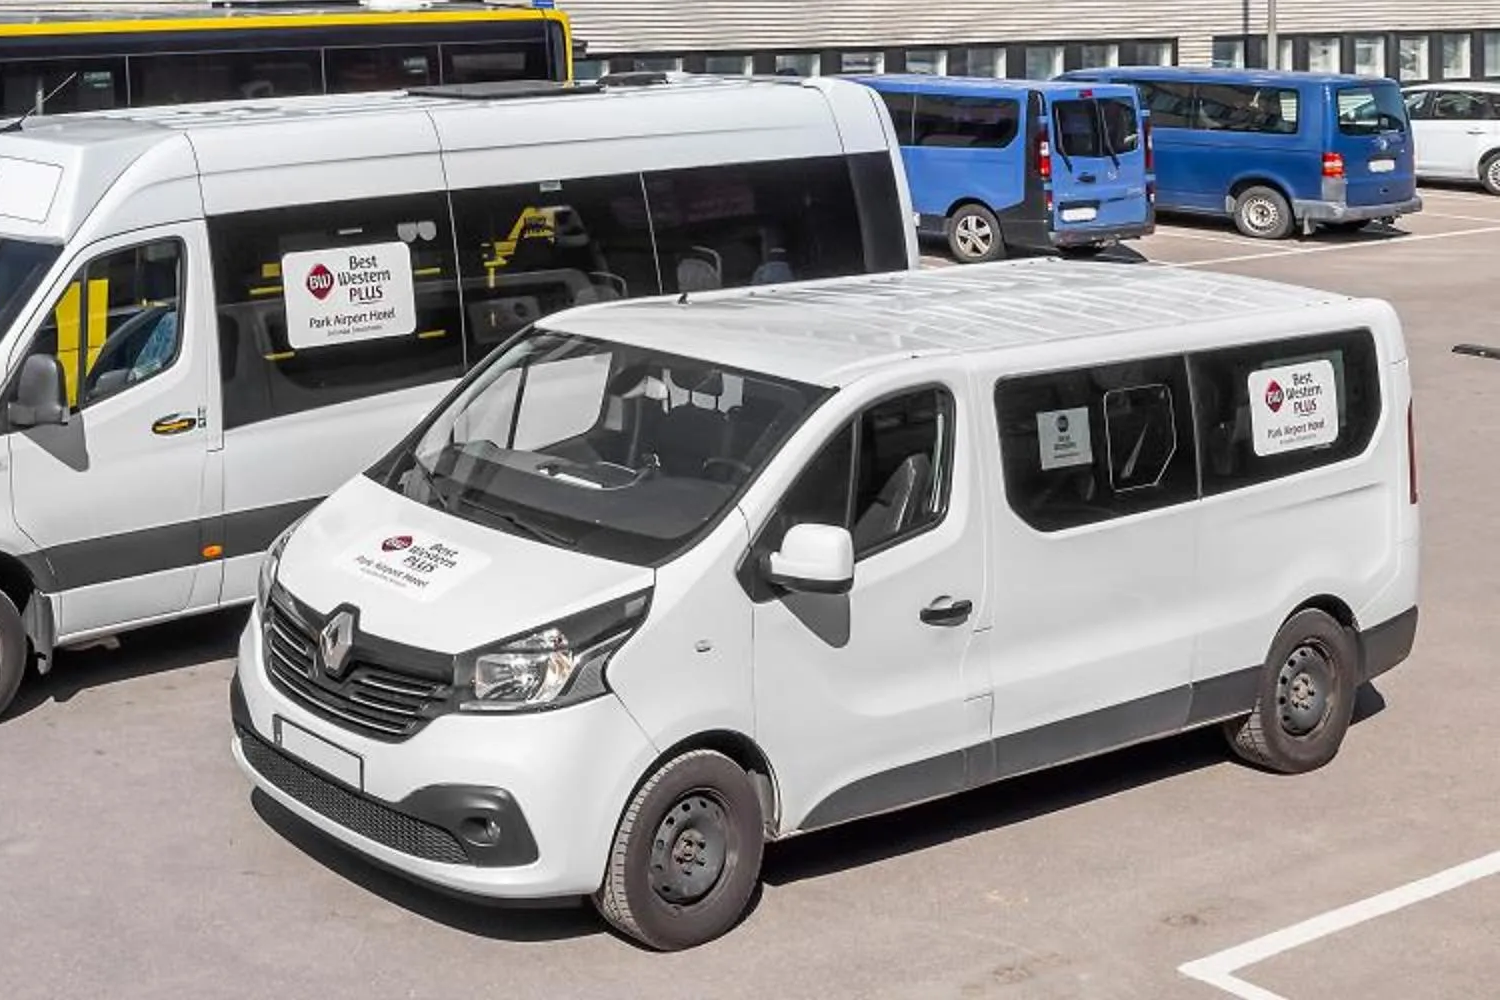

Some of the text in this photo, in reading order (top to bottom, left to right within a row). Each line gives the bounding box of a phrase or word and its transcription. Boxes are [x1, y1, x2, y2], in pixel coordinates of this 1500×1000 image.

[349, 255, 377, 270] Best
[309, 274, 331, 289] BW
[337, 270, 391, 287] Western
[349, 286, 383, 302] PLUS
[309, 307, 396, 329] Park Airport Hotel
[1292, 372, 1313, 386] Best
[1286, 385, 1323, 400] Western
[1293, 398, 1317, 414] PLUS
